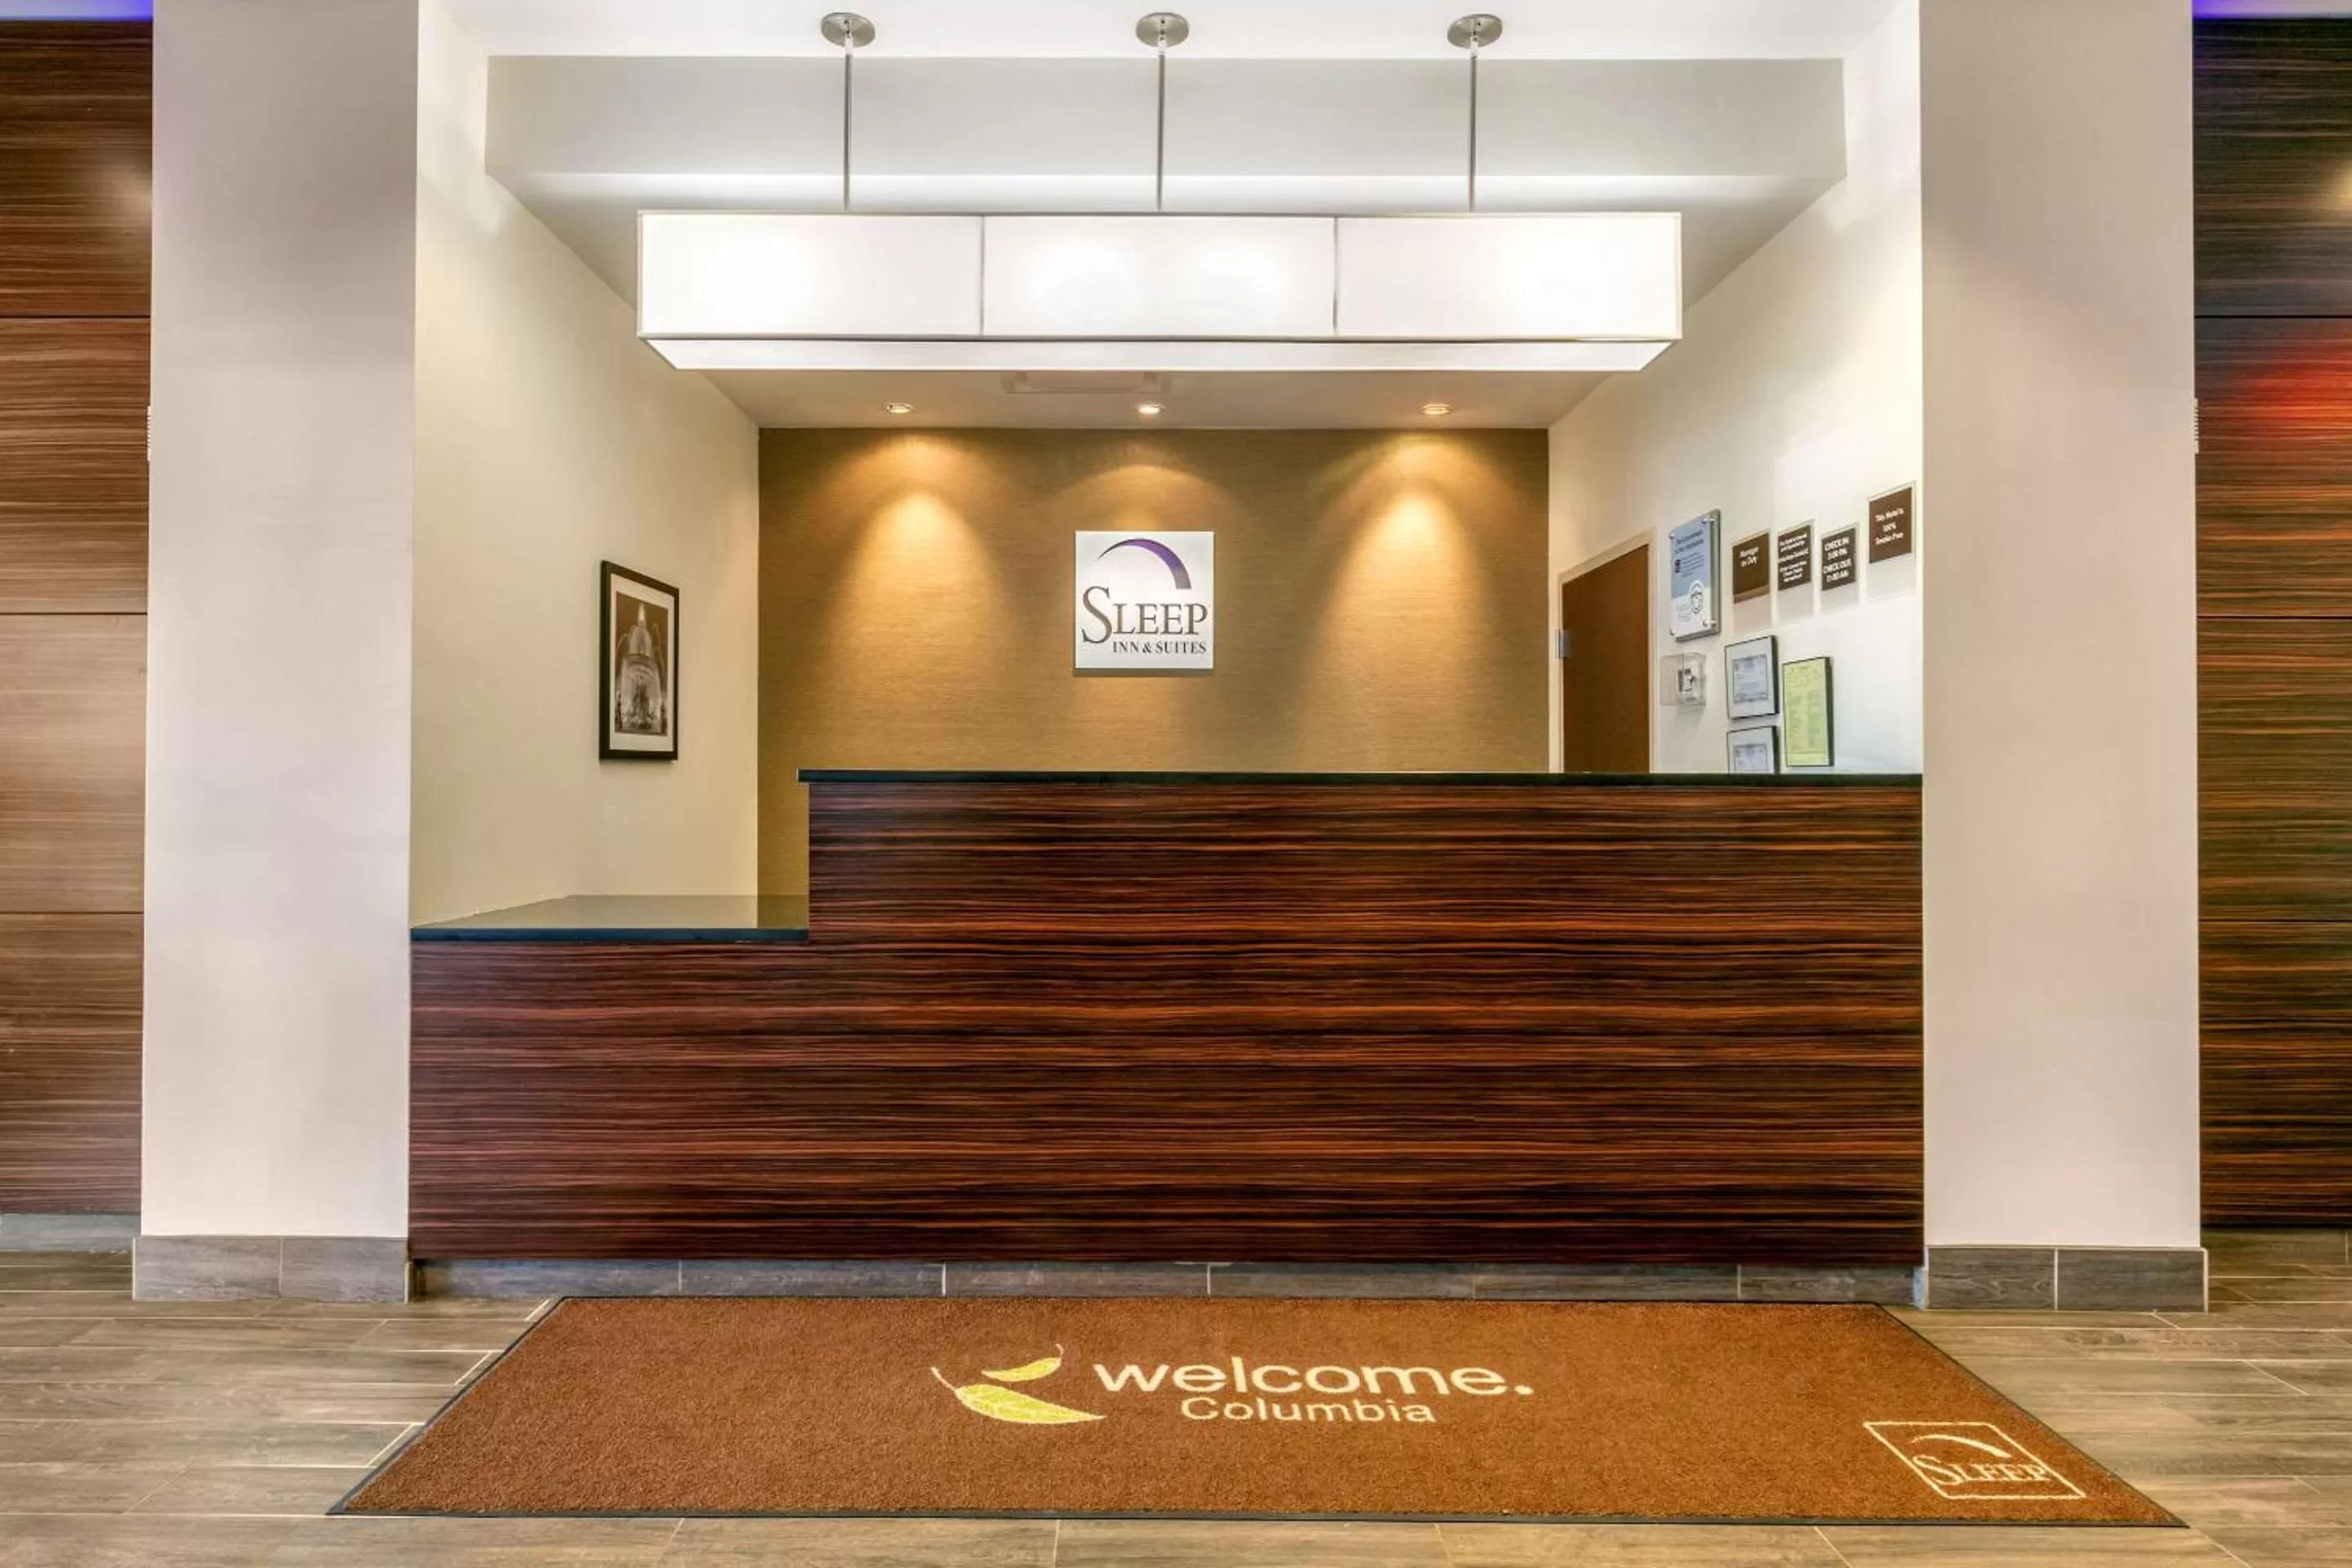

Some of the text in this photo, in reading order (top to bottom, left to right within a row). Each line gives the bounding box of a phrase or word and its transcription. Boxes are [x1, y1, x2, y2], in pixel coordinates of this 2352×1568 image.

[1824, 539, 1842, 551] CHECK
[1823, 558, 1851, 574] CHECK OUT
[1081, 586, 1208, 644] SLEEP
[1113, 640, 1207, 654] INN & SUITES
[1093, 1356, 1535, 1395] welcome.
[1181, 1396, 1437, 1423] Columbia
[1912, 1454, 2051, 1486] SLEEP
